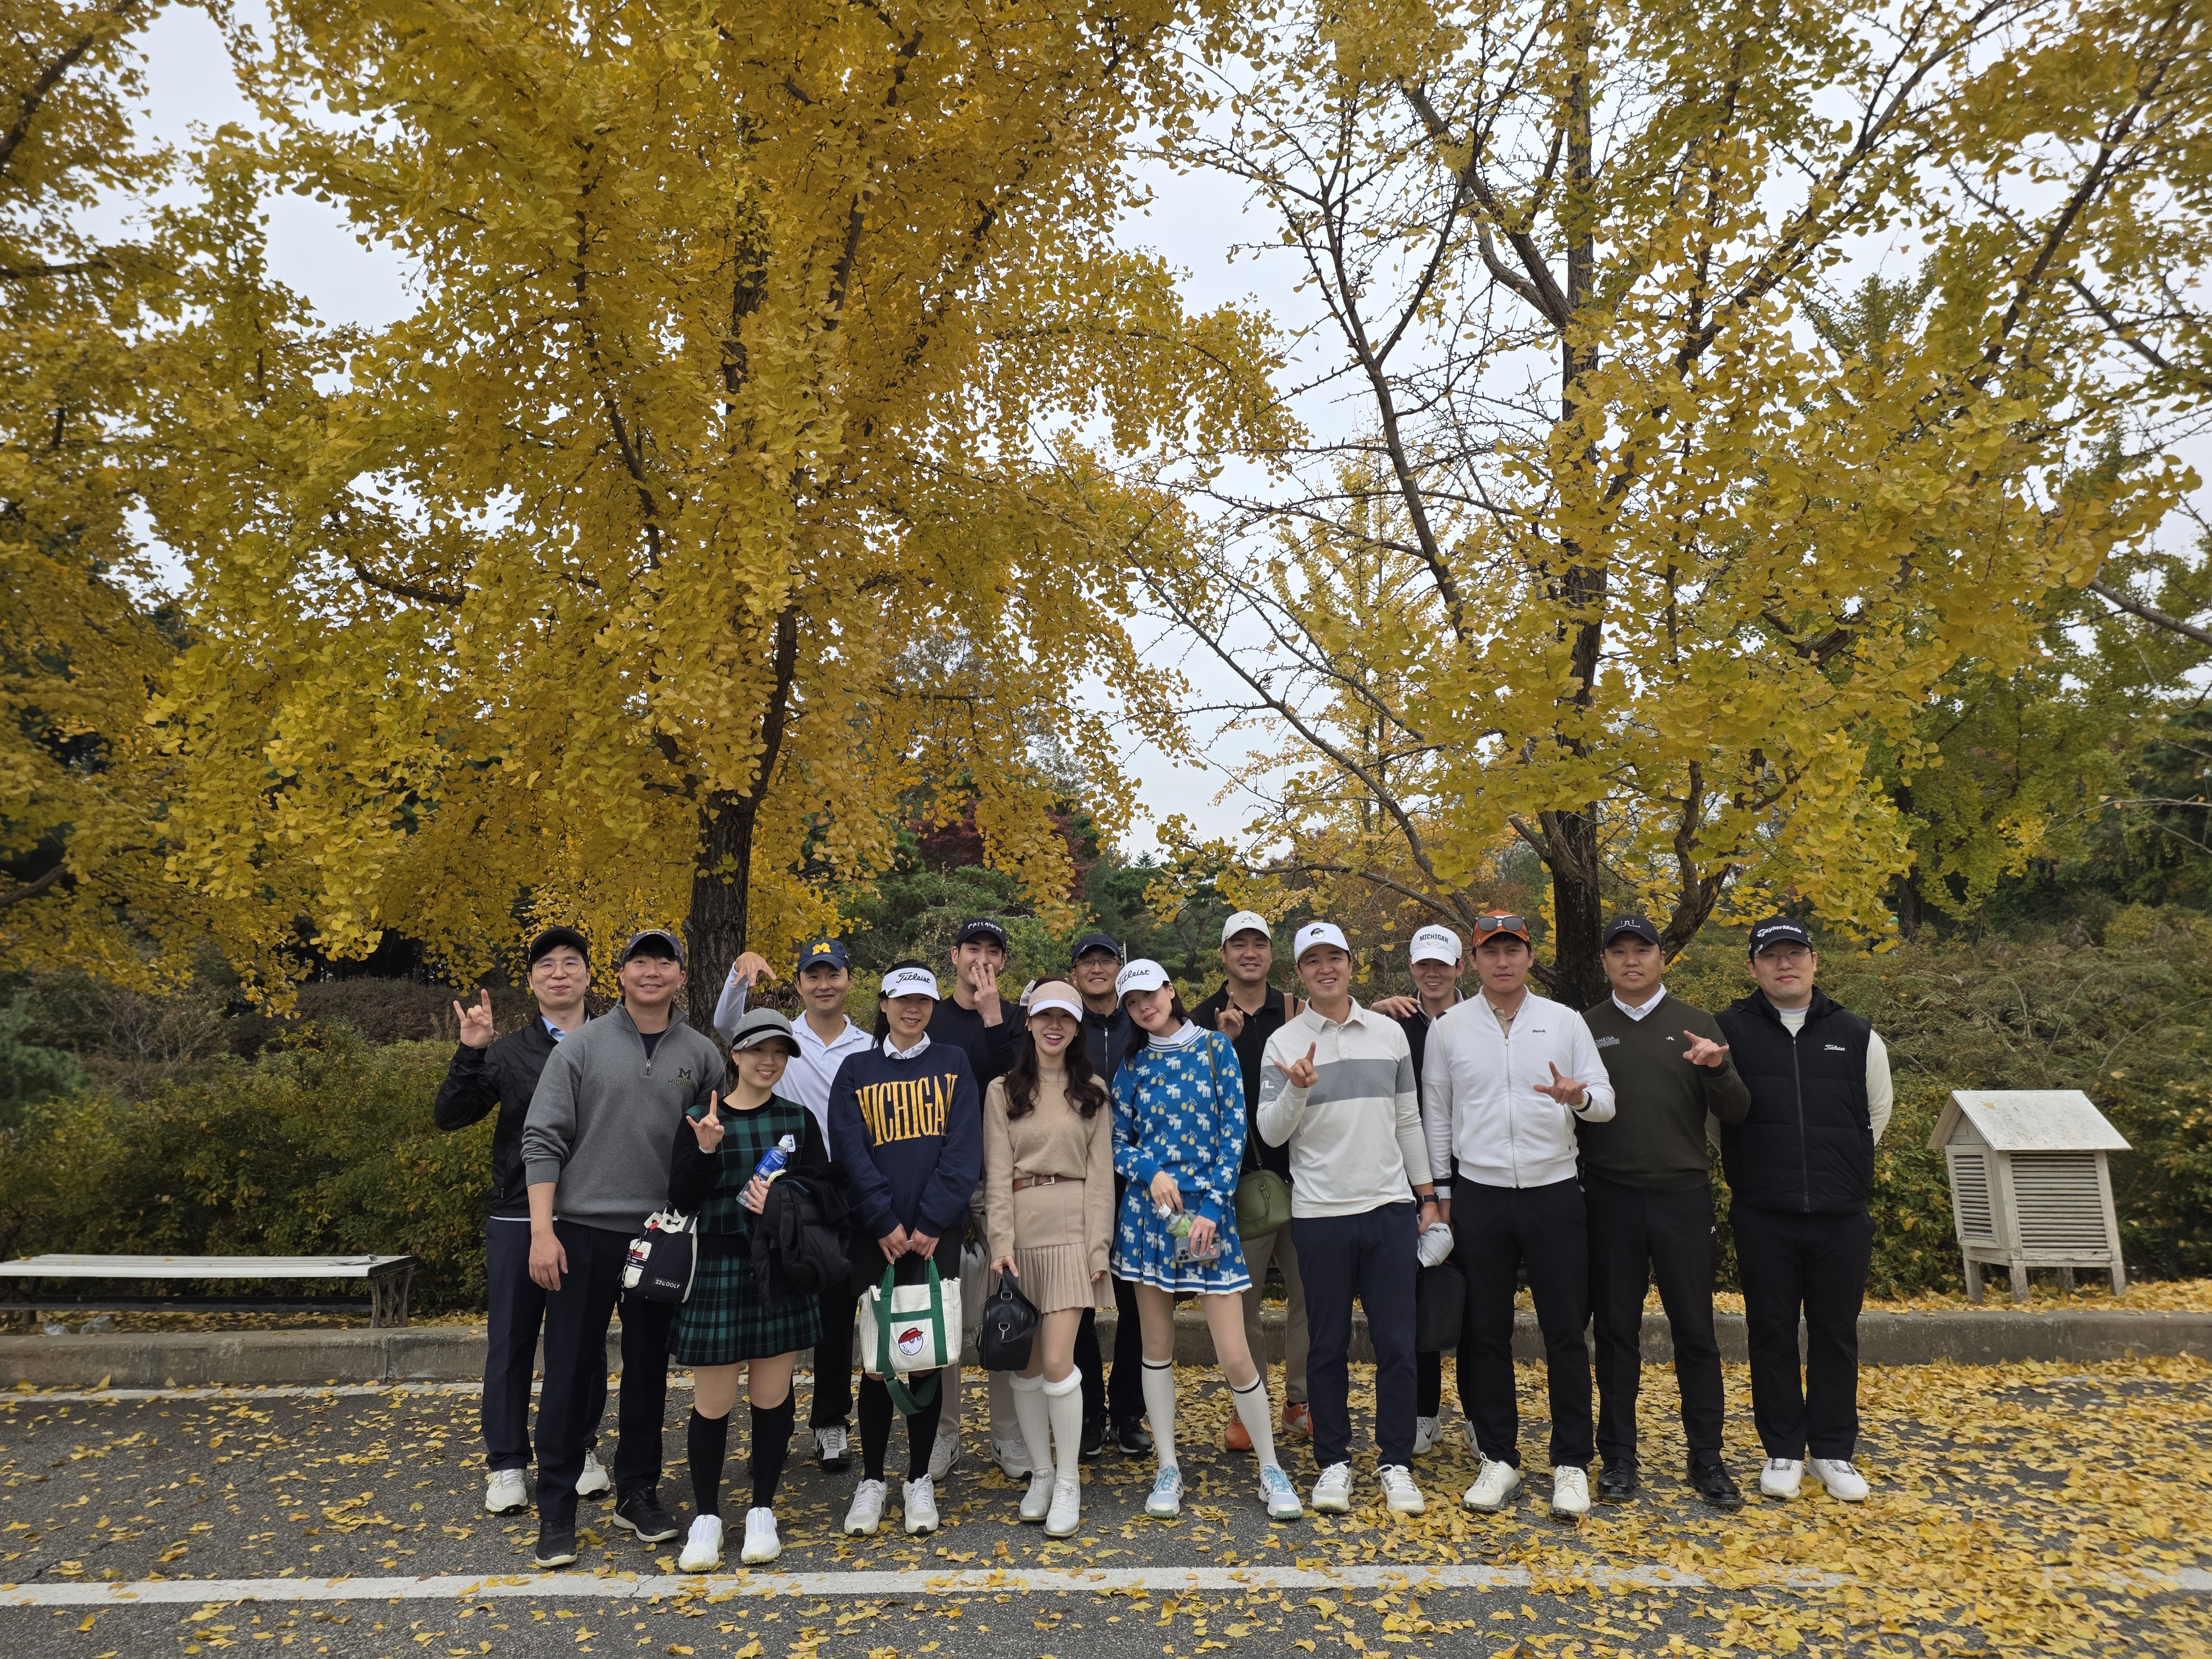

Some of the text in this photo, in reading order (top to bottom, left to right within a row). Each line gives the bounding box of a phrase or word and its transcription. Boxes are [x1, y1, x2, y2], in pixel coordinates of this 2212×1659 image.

[1757, 925, 1802, 937] TaylorMade
[1420, 934, 1449, 944] MICHIGAN
[812, 942, 831, 956] M
[896, 972, 931, 983] Titleist
[1117, 969, 1150, 992] Titleist
[1595, 1036, 1615, 1044] OMEGA
[677, 1067, 692, 1081] M
[667, 1078, 696, 1089] MICHIGAN
[855, 1073, 958, 1147] MICHIGAN
